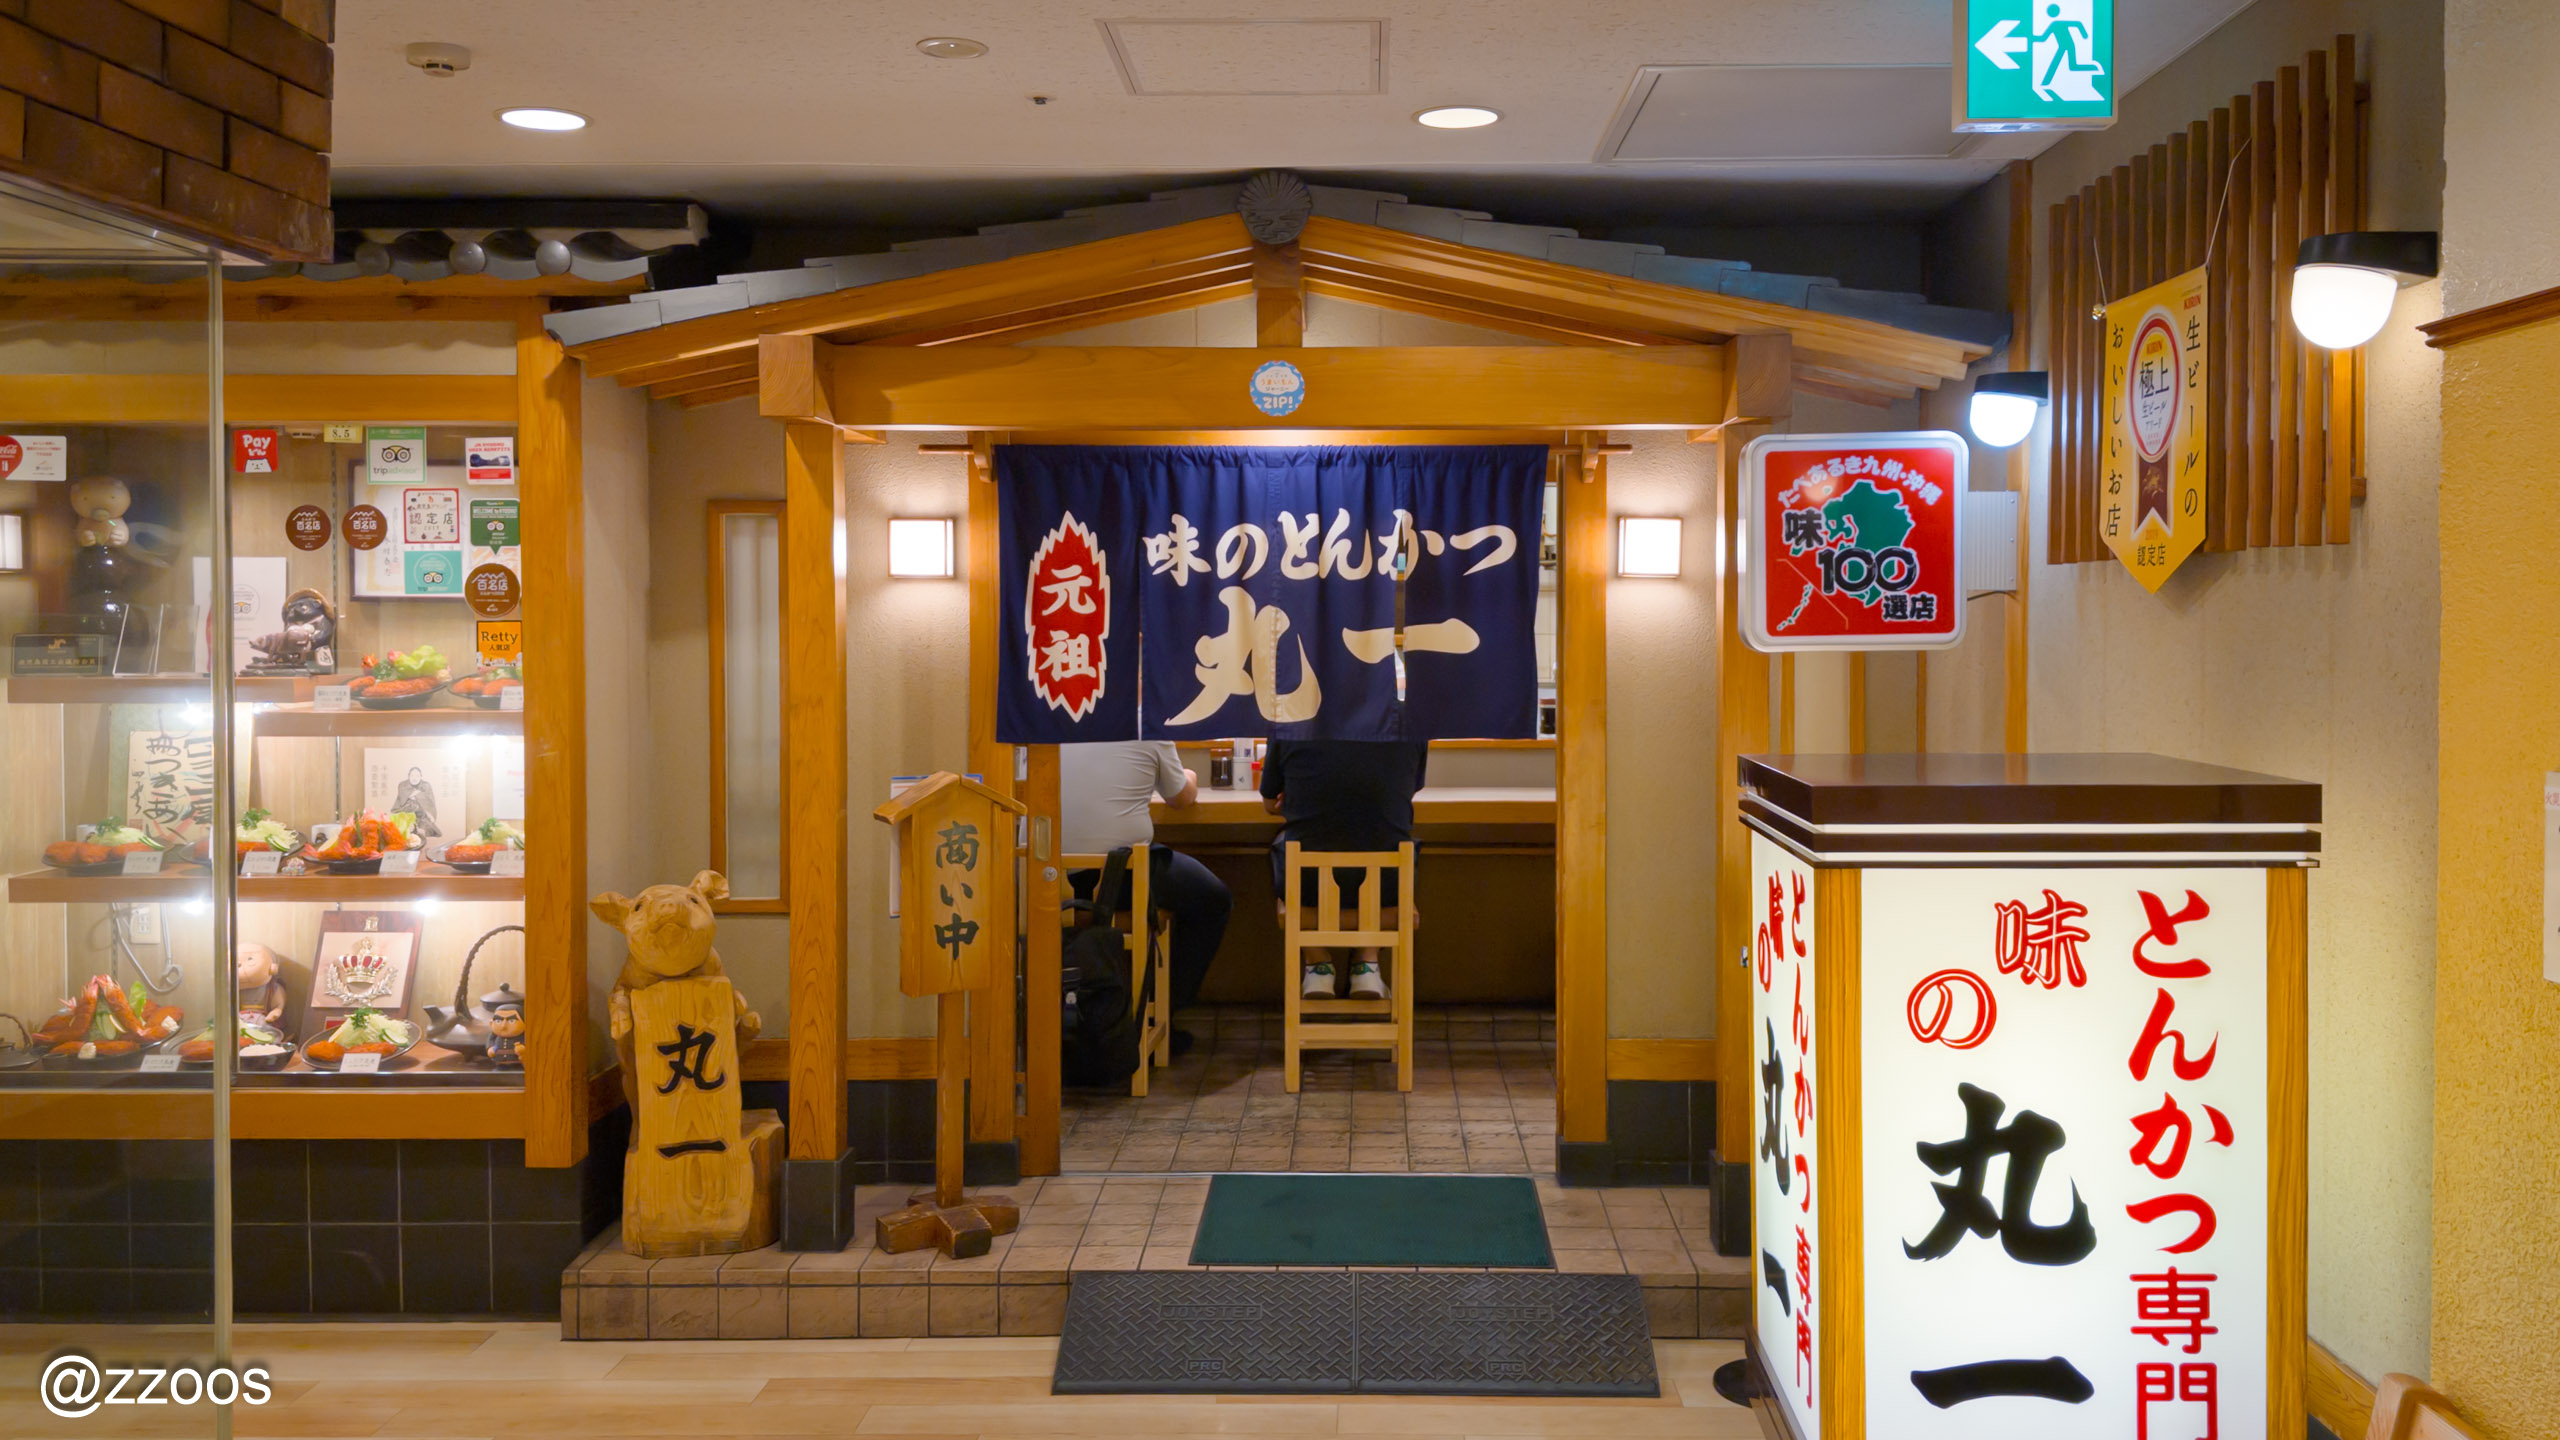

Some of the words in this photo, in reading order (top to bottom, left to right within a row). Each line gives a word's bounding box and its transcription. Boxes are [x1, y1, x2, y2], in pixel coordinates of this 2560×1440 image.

[2139, 356, 2170, 399] 極上
[1262, 396, 1294, 409] ZIP!
[2184, 314, 2201, 517] 生ビールの
[242, 434, 271, 449] Pay
[2105, 323, 2124, 537] おいしいお店
[296, 521, 321, 531] 百名店
[409, 512, 453, 524] 認定店
[1141, 508, 1518, 586] 味のとんかつ
[2137, 542, 2166, 567] 認定店
[477, 579, 508, 591] 百名店
[1817, 546, 1919, 594] 100
[481, 631, 518, 645] Retty
[1040, 563, 1098, 682] 元祖
[1164, 586, 1481, 727] 丸一
[933, 820, 980, 961] 商い中
[656, 1024, 729, 1159] 丸一
[1902, 1081, 2098, 1410] 丸一
[1163, 1306, 1257, 1318] JOYSTEP
[1455, 1307, 1547, 1319] JOYSTEP
